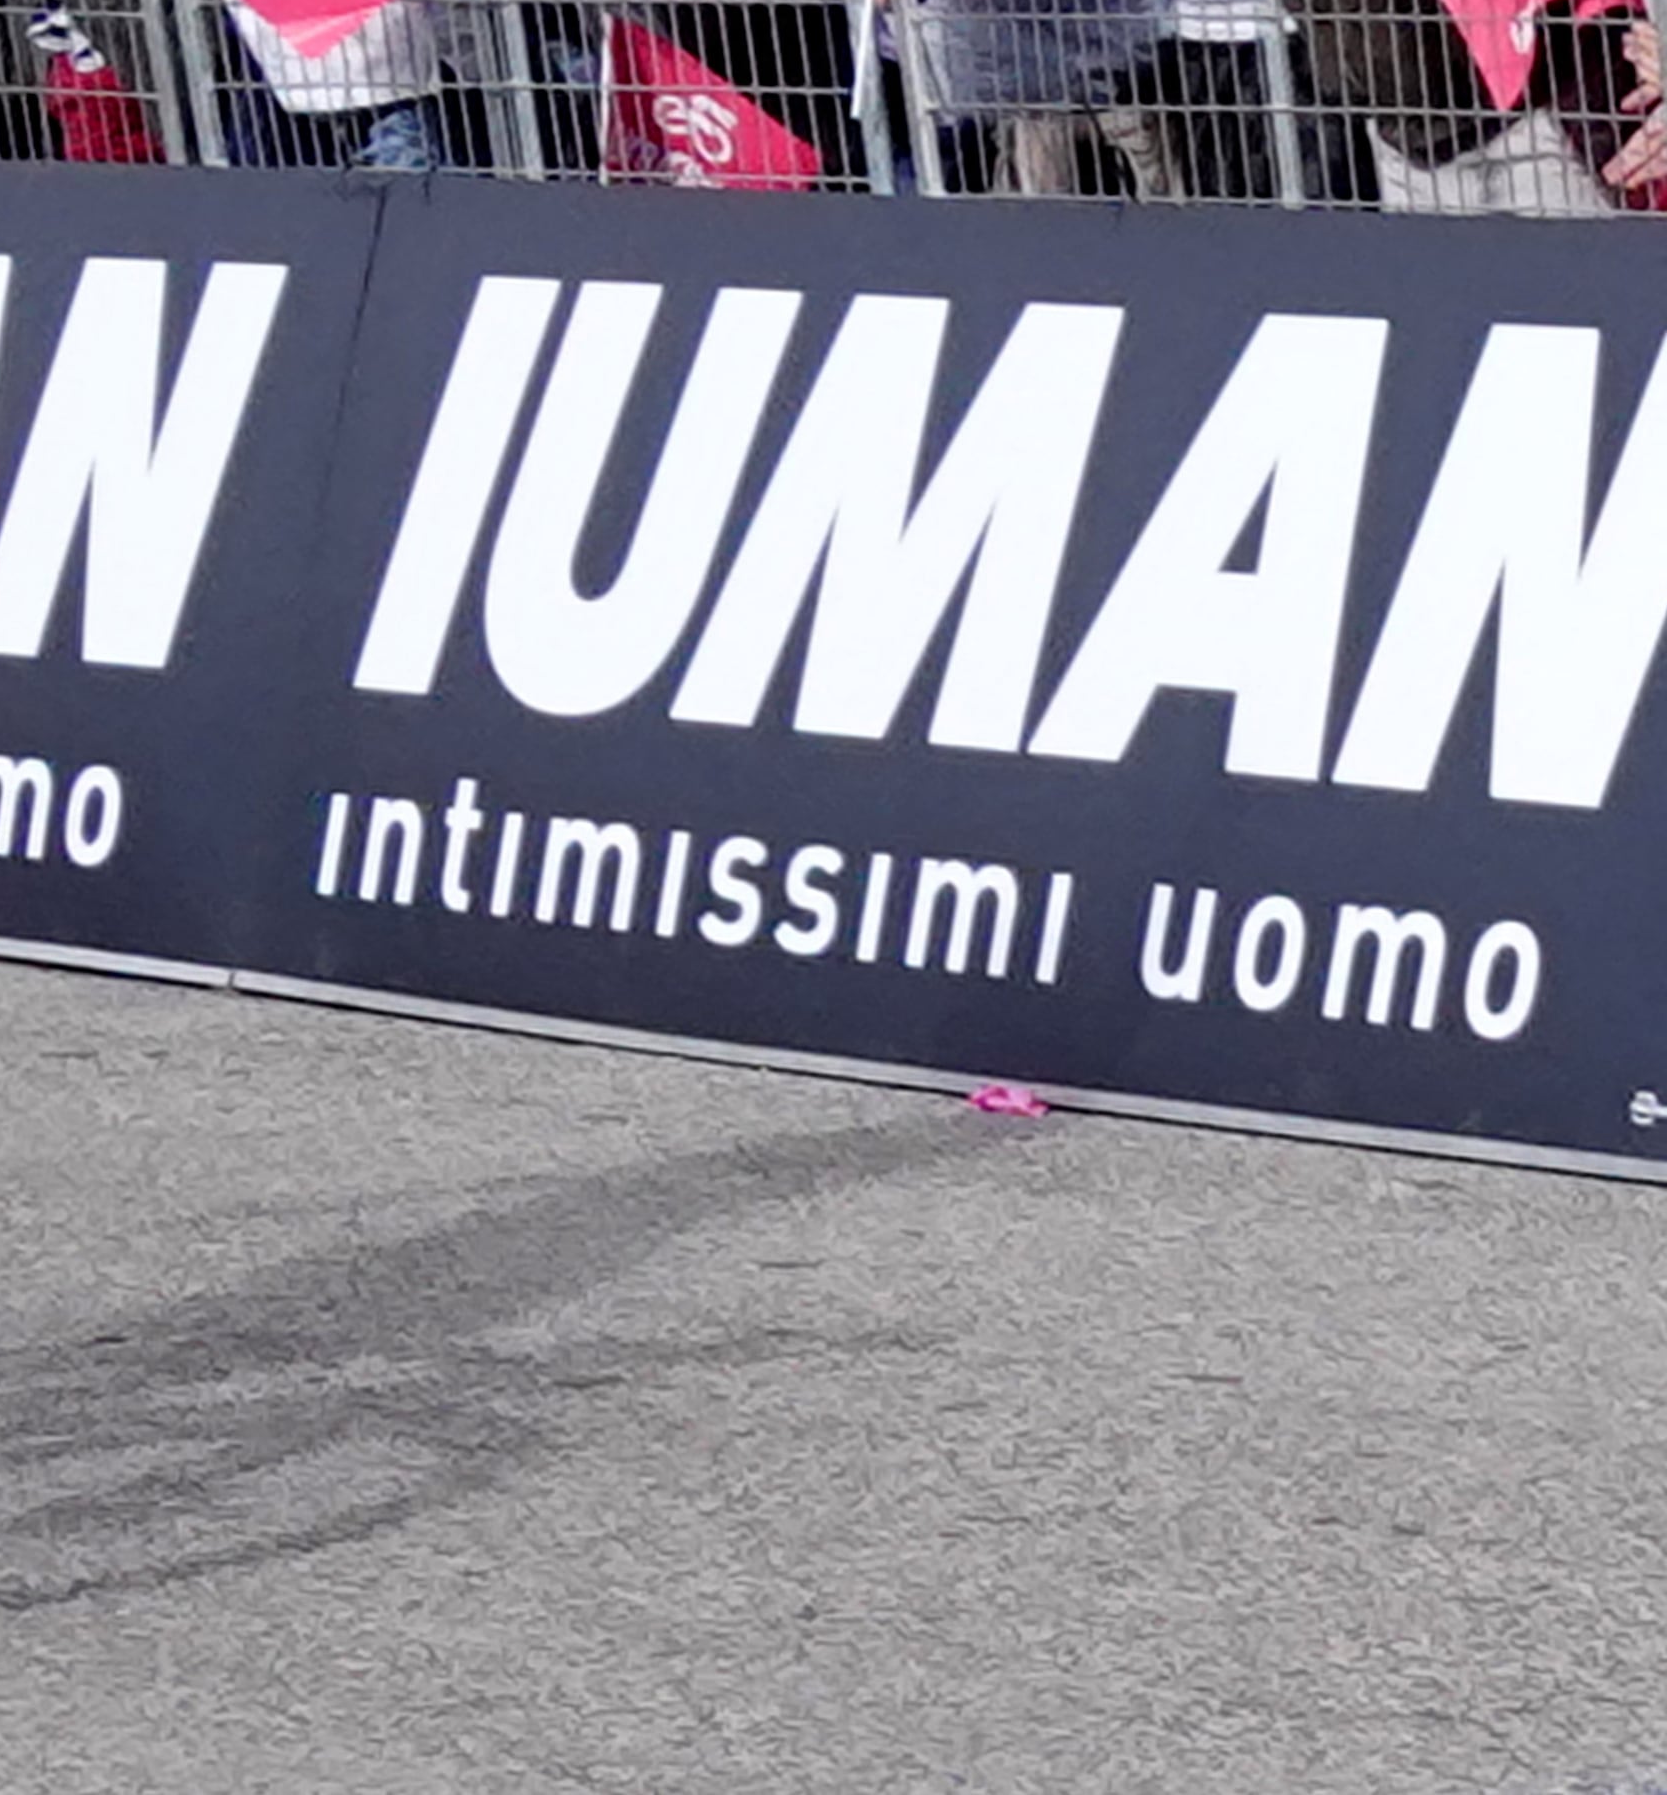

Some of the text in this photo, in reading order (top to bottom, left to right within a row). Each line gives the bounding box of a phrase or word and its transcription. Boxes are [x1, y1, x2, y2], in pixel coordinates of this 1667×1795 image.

[351, 274, 1667, 810] IUMAN
[316, 778, 1541, 1041] intimissimi uomo
